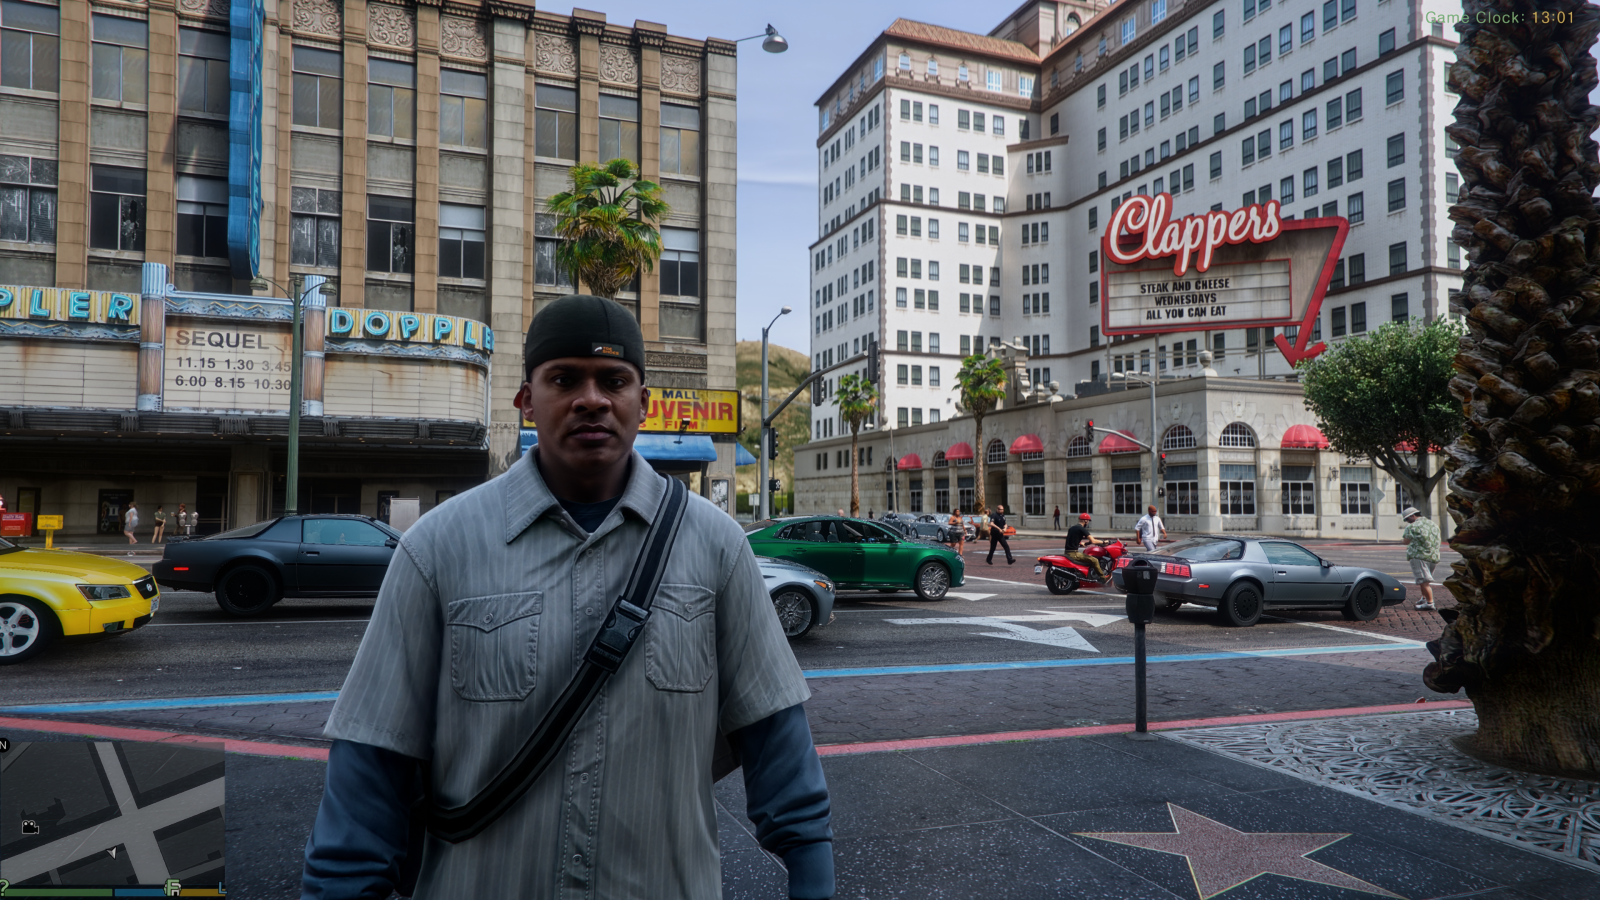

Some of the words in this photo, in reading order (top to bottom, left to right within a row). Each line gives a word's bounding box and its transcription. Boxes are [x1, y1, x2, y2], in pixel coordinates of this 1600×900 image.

[252, 0, 261, 265] PPLER
[1107, 193, 1281, 275] Clappers
[1140, 282, 1169, 294] STEAK
[1172, 281, 1191, 292] AND
[1195, 278, 1230, 290] CHEESE
[1154, 292, 1217, 306] WEDNESDAYS
[1146, 309, 1162, 320] ALL
[1165, 308, 1184, 319] YOU
[1188, 306, 1207, 317] CAN
[1211, 305, 1226, 316] EAT
[331, 308, 494, 351] DOPPLE
[175, 329, 270, 350] SEQUEL
[176, 356, 216, 369] 11.15
[224, 358, 254, 371] 1.30
[261, 360, 291, 372] 3.45
[175, 374, 207, 387] 6.00
[214, 376, 245, 388] 8.15
[254, 378, 291, 390] 10.30
[662, 389, 700, 400] MALL
